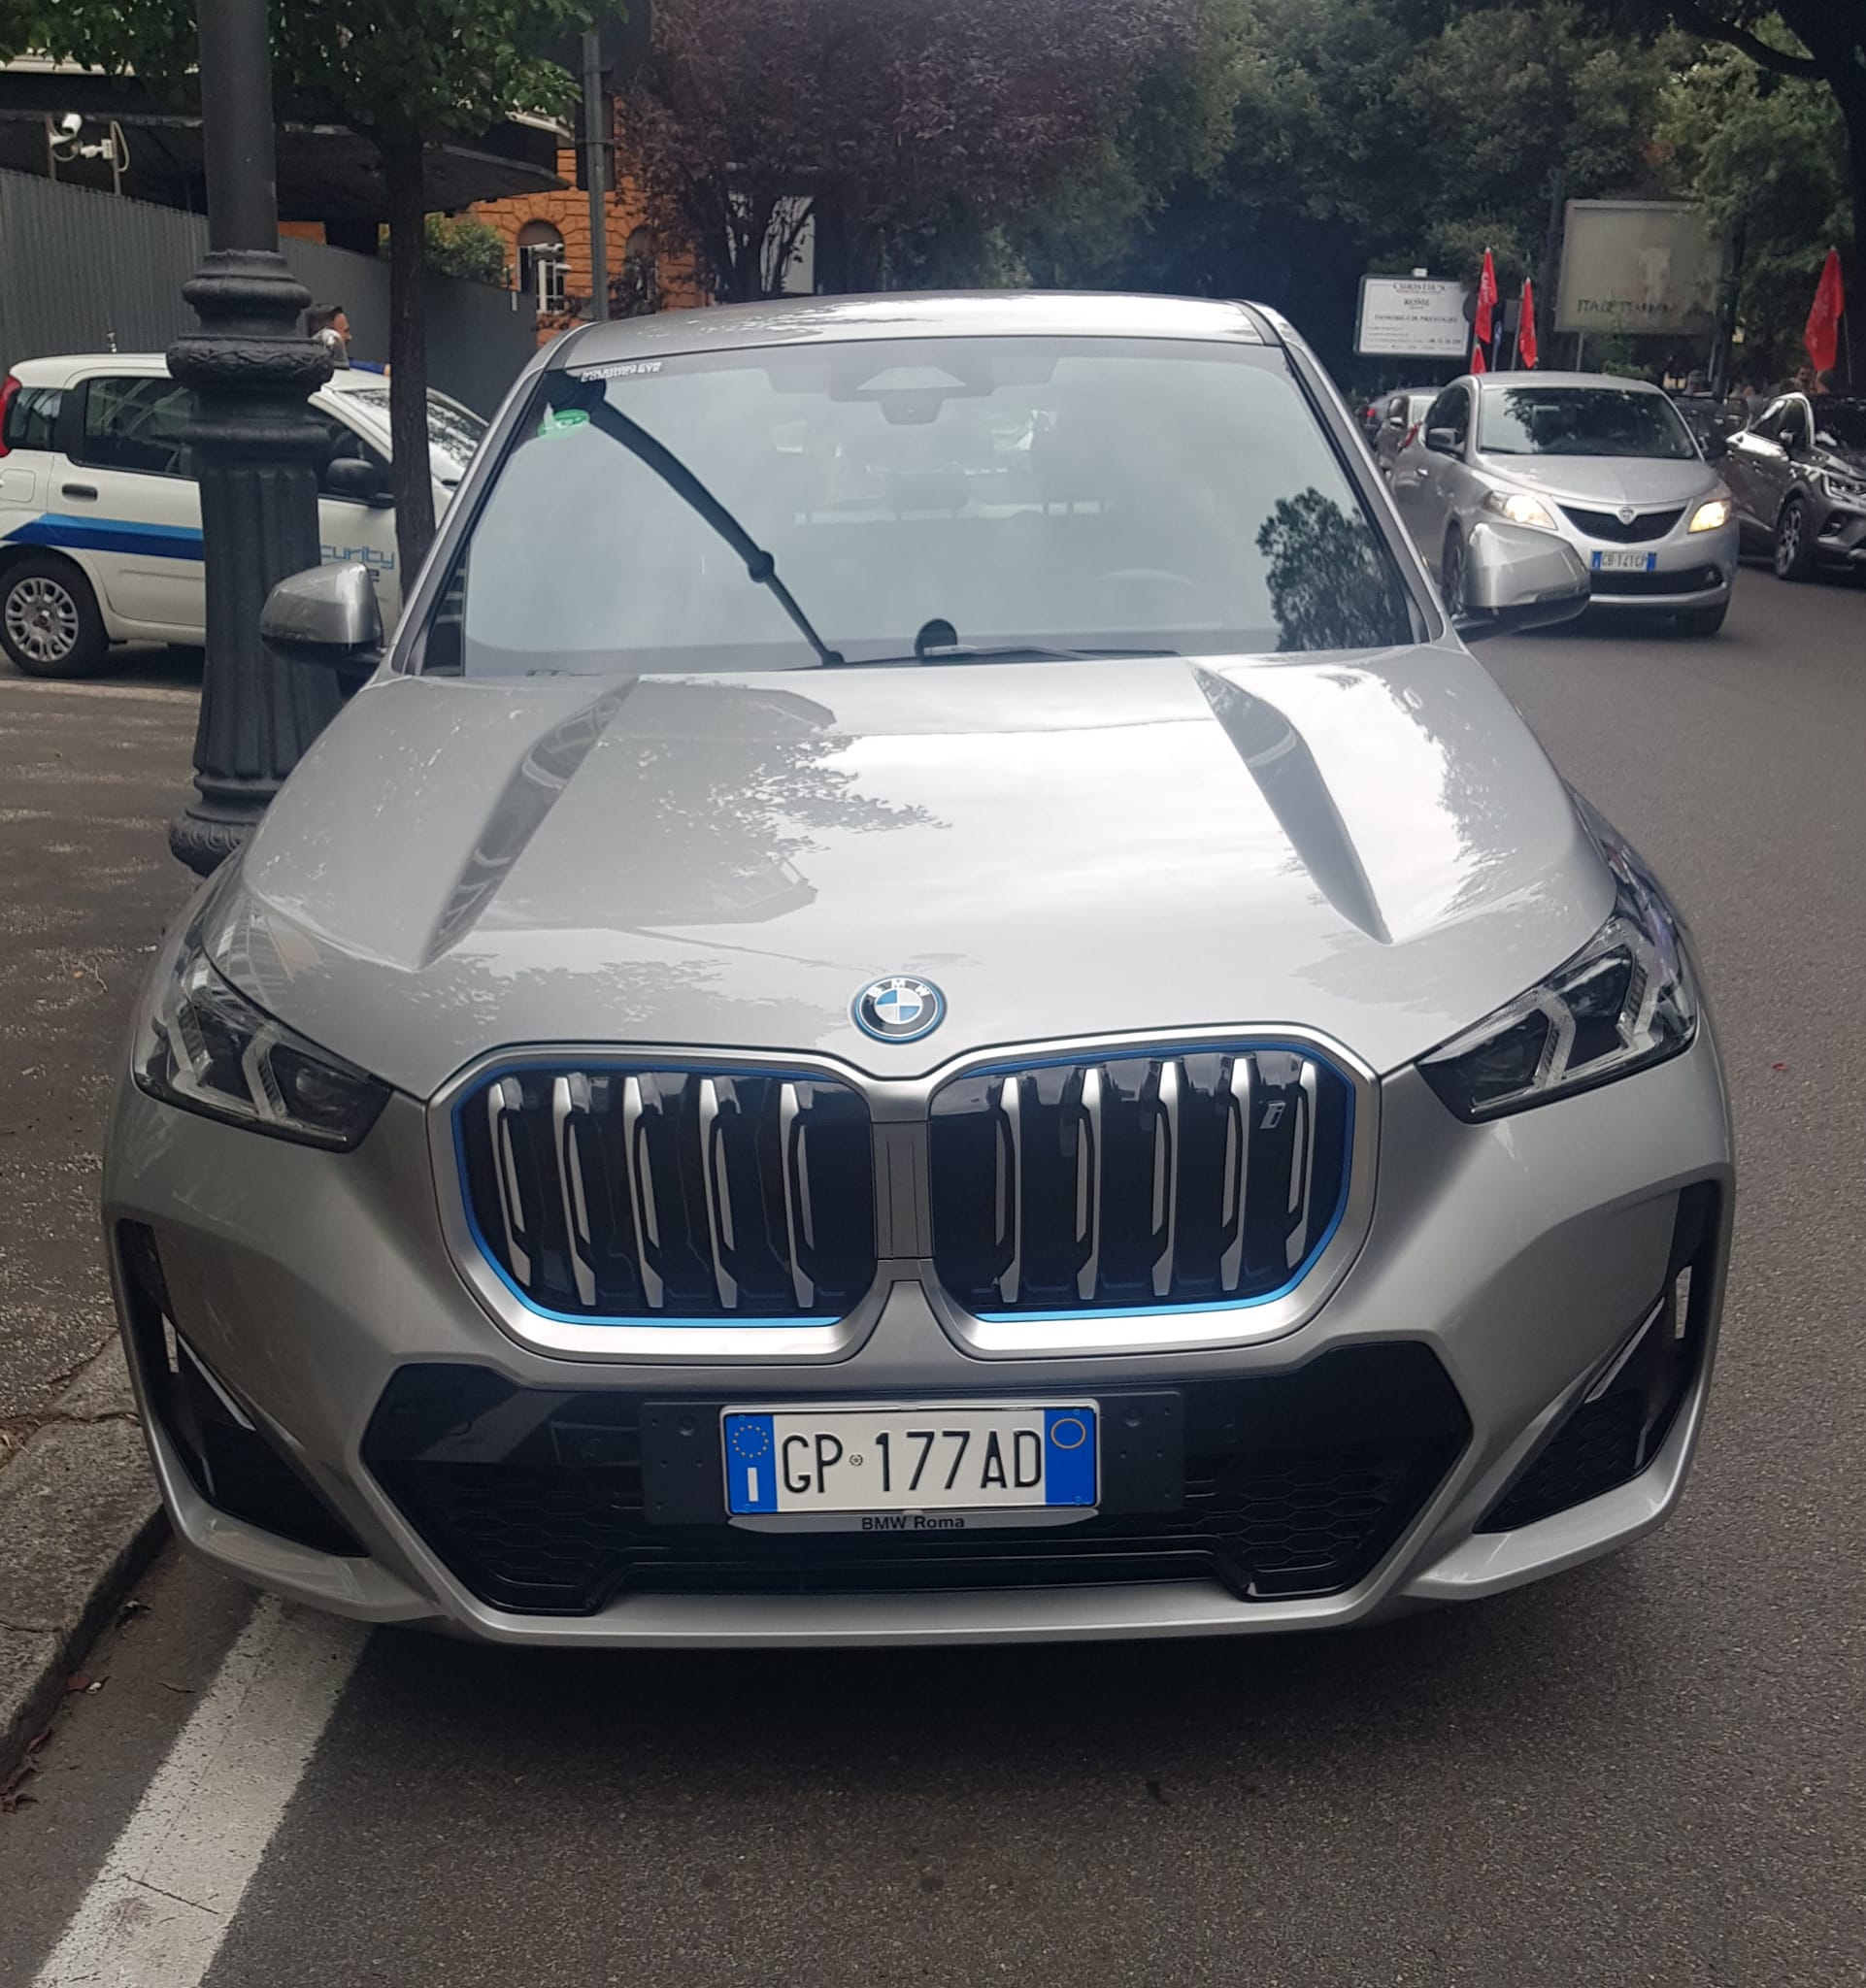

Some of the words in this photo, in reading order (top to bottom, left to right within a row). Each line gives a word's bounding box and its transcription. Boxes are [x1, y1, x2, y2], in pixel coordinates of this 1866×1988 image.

[868, 978, 931, 997] BMW
[782, 1433, 844, 1494] GP
[875, 1430, 1042, 1492] 177AD
[861, 1516, 907, 1531] BMW
[914, 1515, 965, 1530] Roma
